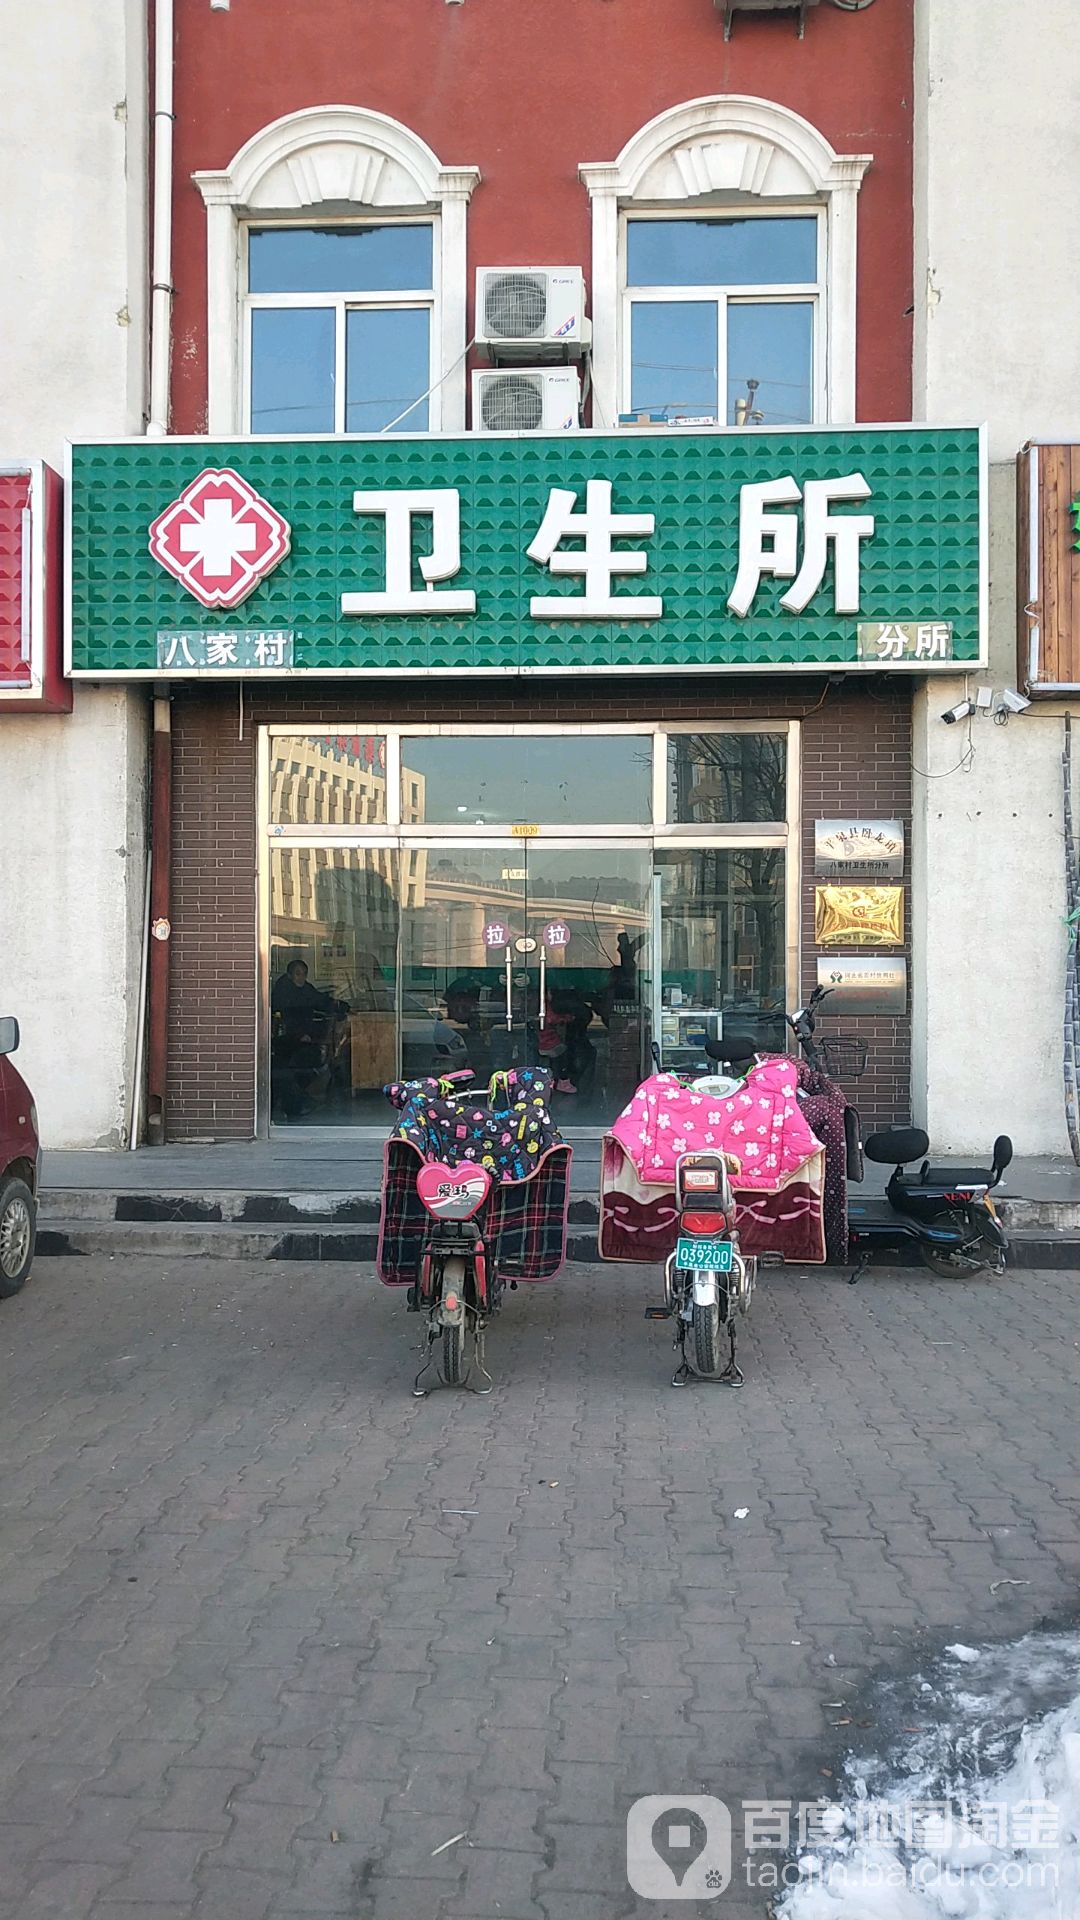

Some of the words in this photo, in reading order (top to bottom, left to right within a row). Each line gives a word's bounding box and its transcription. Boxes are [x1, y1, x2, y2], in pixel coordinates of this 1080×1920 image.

[341, 472, 874, 618] 卫生所
[164, 632, 287, 666] 八家村
[876, 624, 949, 658] 分所
[487, 925, 504, 945] 拉
[548, 925, 566, 945] 拉
[438, 1183, 470, 1199] 爱玛
[680, 1247, 729, 1265] 039200
